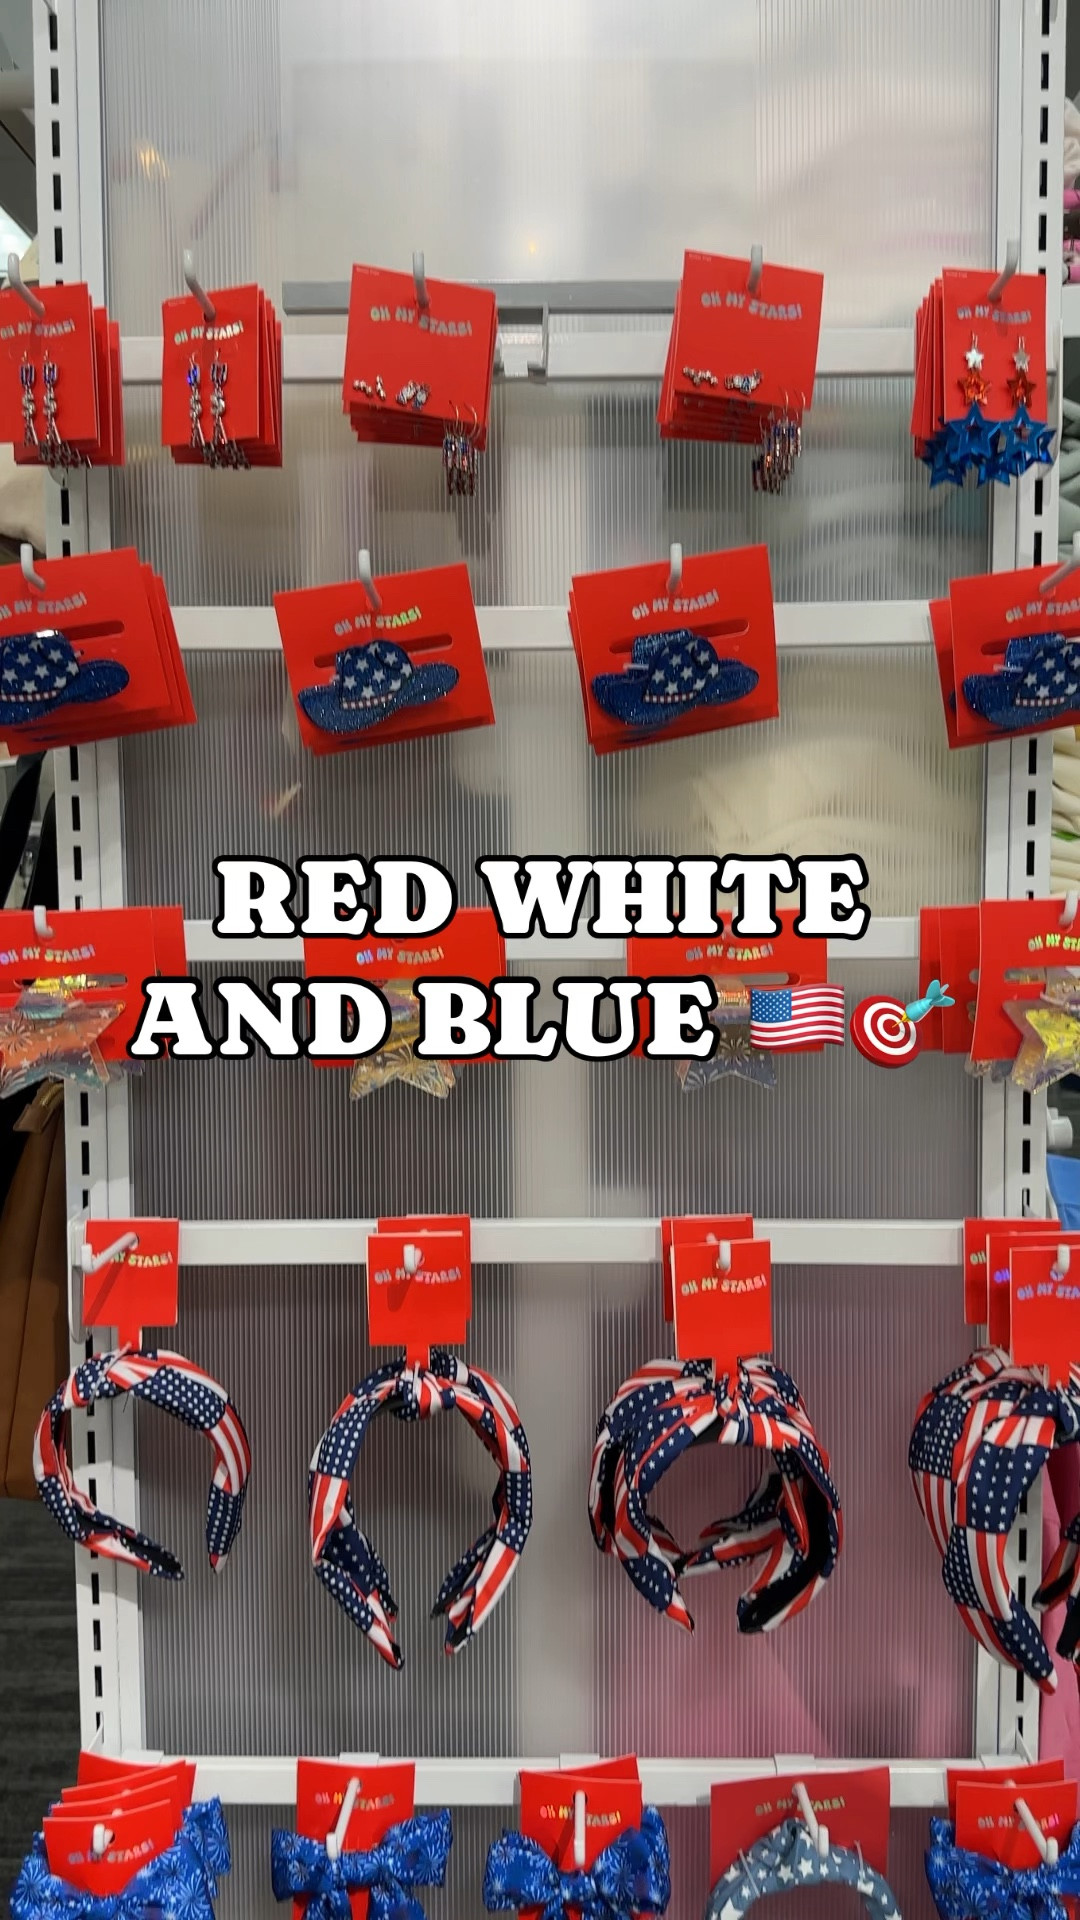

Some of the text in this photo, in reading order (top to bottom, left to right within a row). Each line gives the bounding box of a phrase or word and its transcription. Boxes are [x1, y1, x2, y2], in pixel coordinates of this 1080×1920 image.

[701, 291, 802, 321] OH MY STARS!
[975, 304, 990, 318] MY
[370, 306, 472, 337] OH MY STARS!
[174, 320, 244, 345] OH MY STARS!
[14, 598, 32, 614] MY
[632, 589, 719, 620] OH MY STARS!
[1026, 601, 1042, 616] MY
[334, 606, 422, 636] OH MY STARS!
[686, 943, 773, 962] OH MY STARS!
[1028, 935, 1043, 952] OH
[1046, 933, 1060, 947] MY
[0, 944, 95, 965] OH MY STARS!
[356, 946, 444, 965] OH MY STARS!
[374, 1269, 392, 1285] OH
[681, 1274, 766, 1297] OH MY STARS!
[1037, 1282, 1054, 1297] MY
[540, 1804, 555, 1819] OH
[586, 1810, 621, 1828] TARS!
